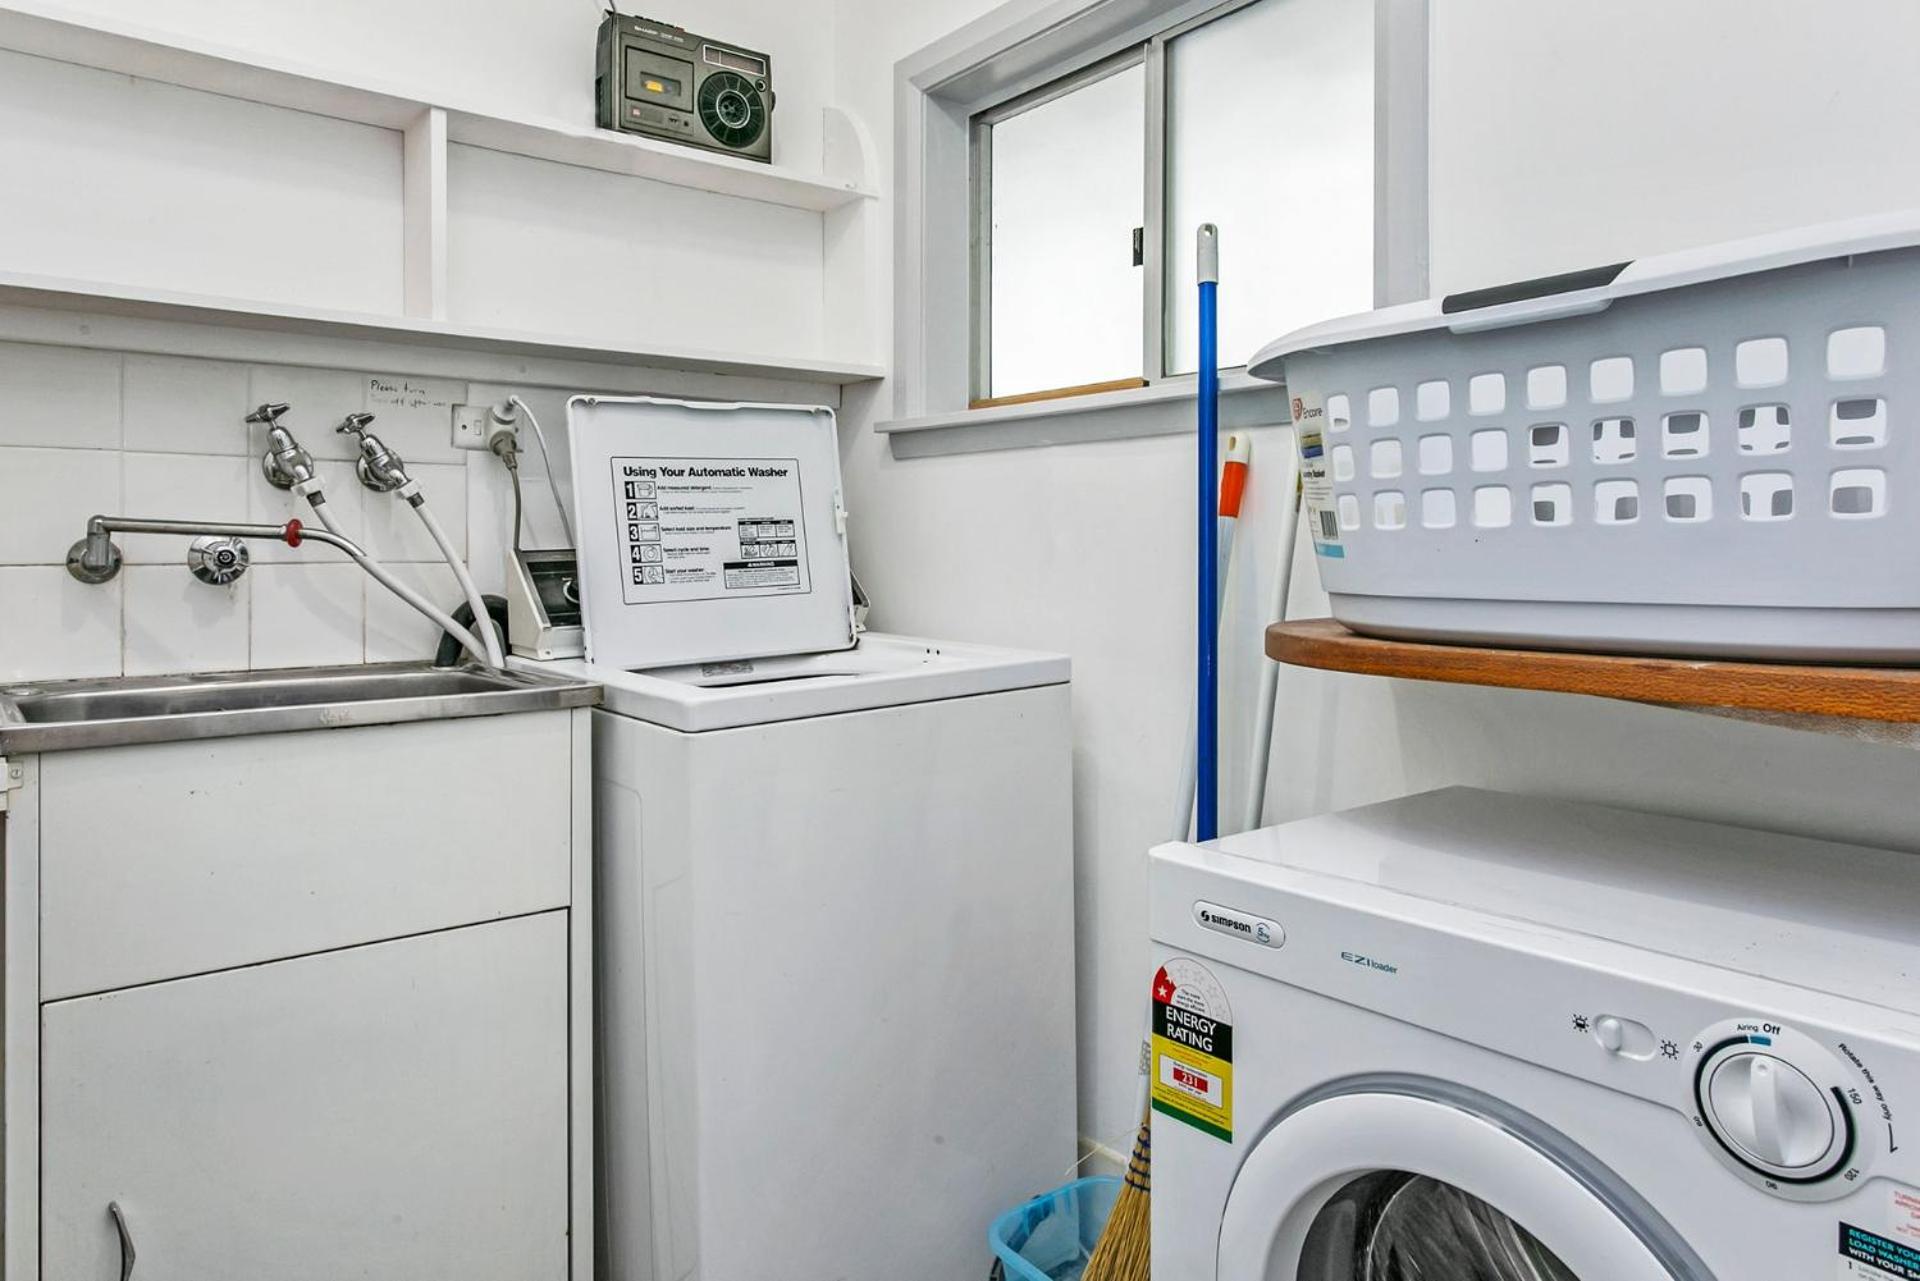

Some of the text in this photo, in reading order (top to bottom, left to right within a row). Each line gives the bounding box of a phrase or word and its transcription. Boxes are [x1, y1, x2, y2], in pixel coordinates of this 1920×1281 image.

[623, 466, 788, 479] Using Your Automatic Washer
[628, 504, 637, 519] 2
[629, 525, 638, 539] 3
[631, 547, 640, 561] 4
[634, 568, 642, 582] 5
[1166, 1005, 1217, 1036] ENERGY
[1763, 1023, 1781, 1035] Off
[1166, 1023, 1213, 1052] RATING
[1182, 1072, 1198, 1087] 231
[1848, 1087, 1862, 1105] 150
[1849, 1228, 1894, 1252] REGISTER
[1849, 1238, 1919, 1270] LOAD WASHER
[1849, 1247, 1874, 1263] WITH
[1876, 1257, 1905, 1275] YOUR
